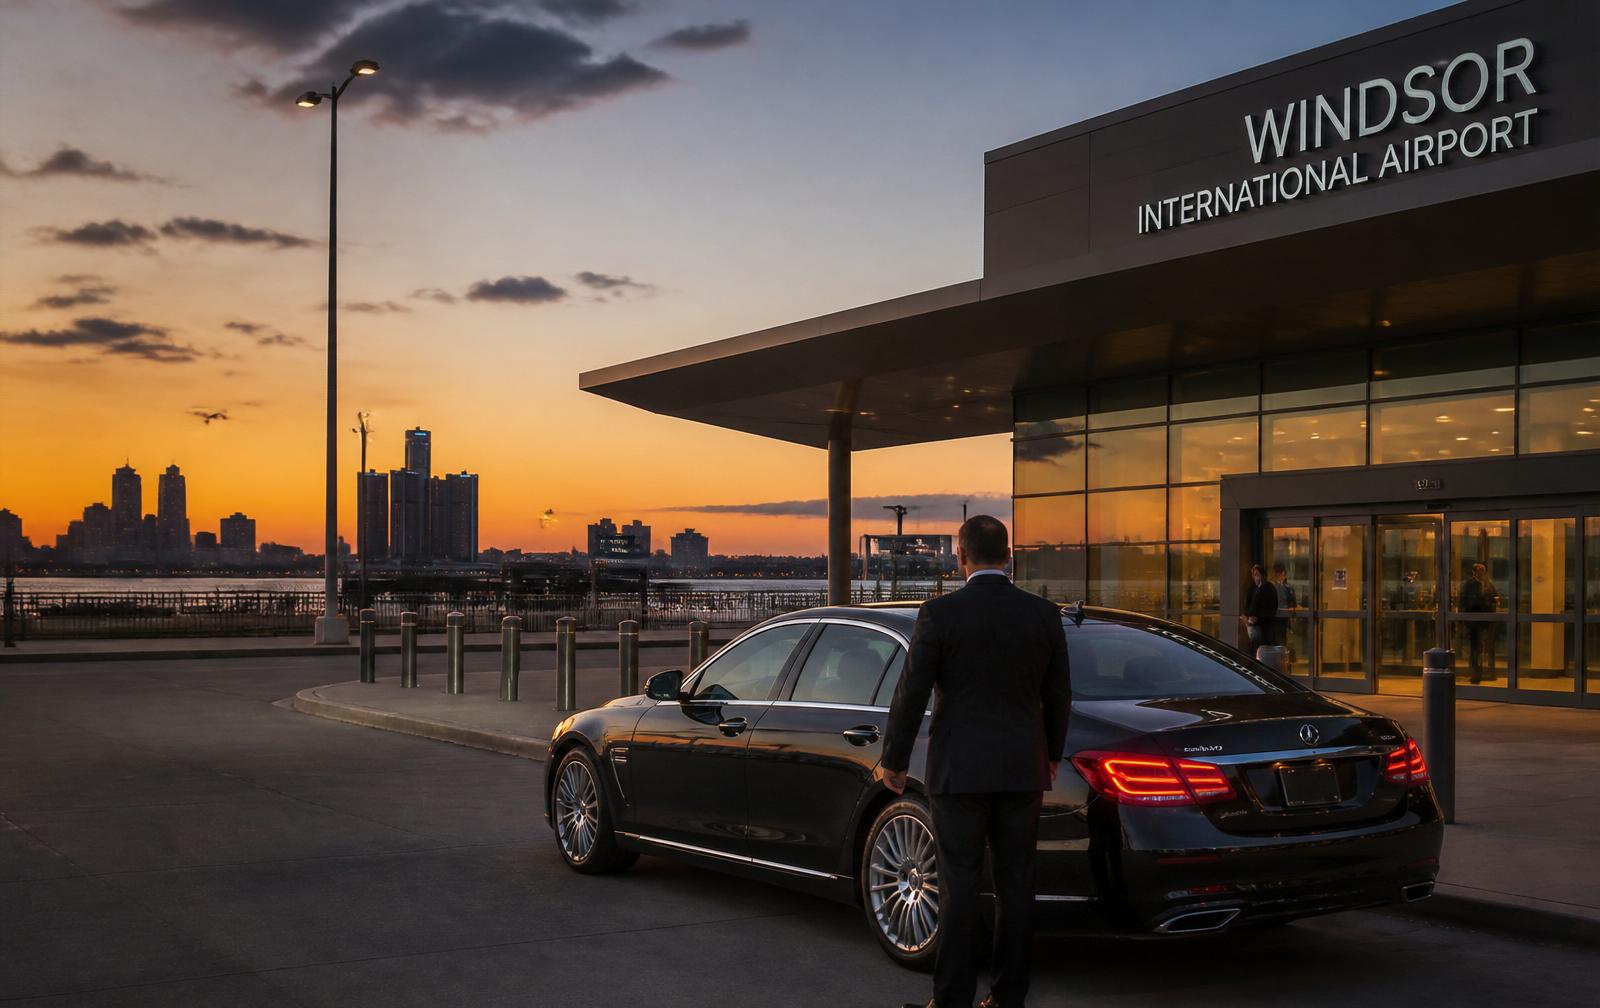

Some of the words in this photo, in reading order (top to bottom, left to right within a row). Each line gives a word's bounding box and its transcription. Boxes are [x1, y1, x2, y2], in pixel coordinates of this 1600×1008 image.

[1244, 38, 1537, 164] WINDSOR
[1137, 152, 1369, 234] INTERNATIONAL
[1378, 107, 1538, 178] AIRPORT
